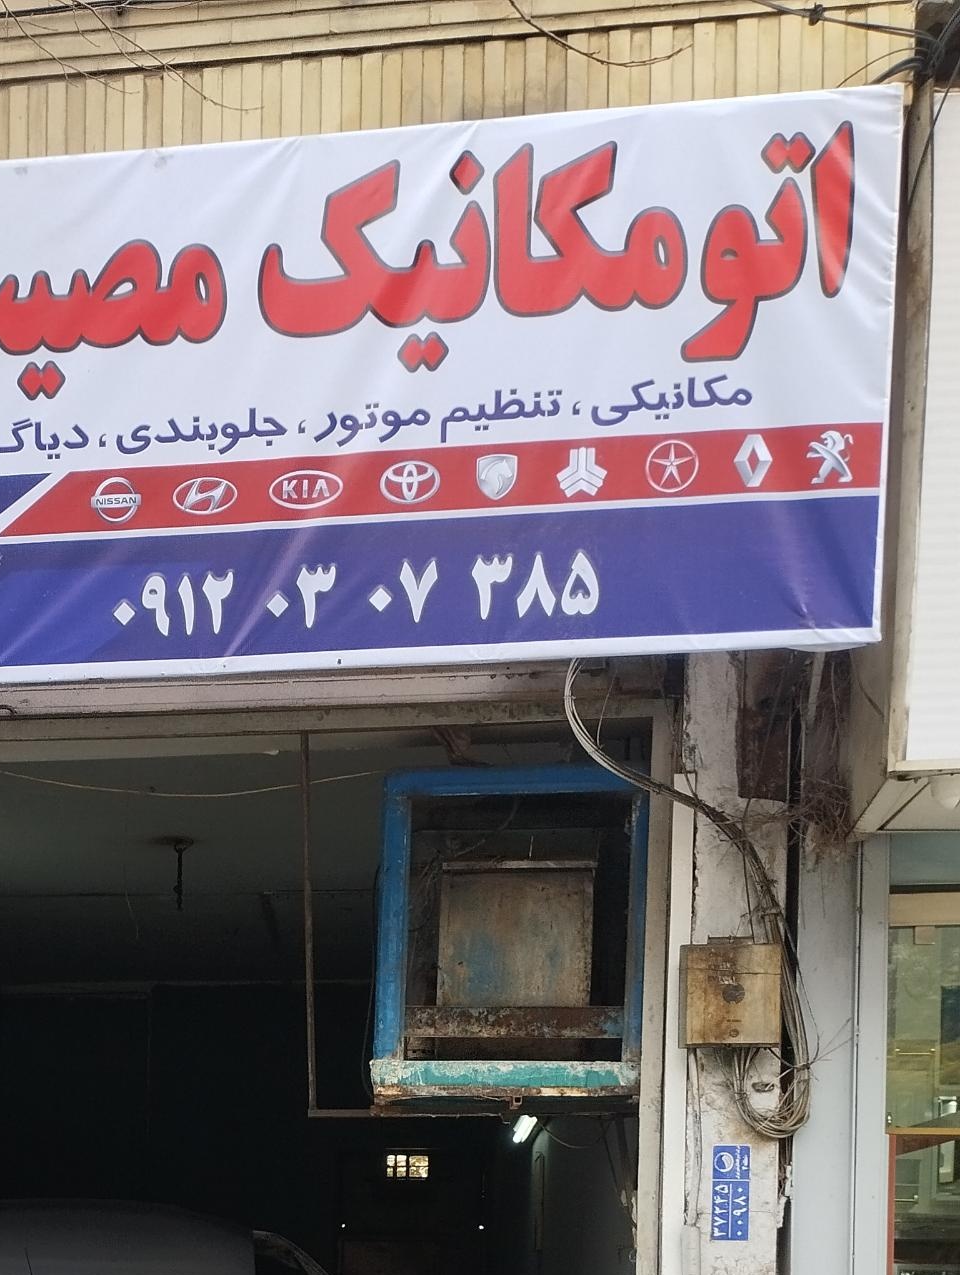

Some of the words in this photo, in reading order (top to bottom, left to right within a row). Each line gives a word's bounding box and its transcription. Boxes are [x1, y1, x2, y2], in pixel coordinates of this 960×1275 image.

[440, 388, 563, 444] تنظیم
[591, 374, 753, 427] مکانیکی
[115, 407, 288, 455] جلوبندی
[313, 402, 431, 448] موتور
[95, 496, 137, 506] NISSAN
[282, 479, 330, 499] KIA
[113, 571, 234, 637] ۰۹۱۲
[265, 565, 337, 629] ۰۳
[367, 559, 439, 623] ۰۷
[470, 551, 600, 620] ۳۸۵
